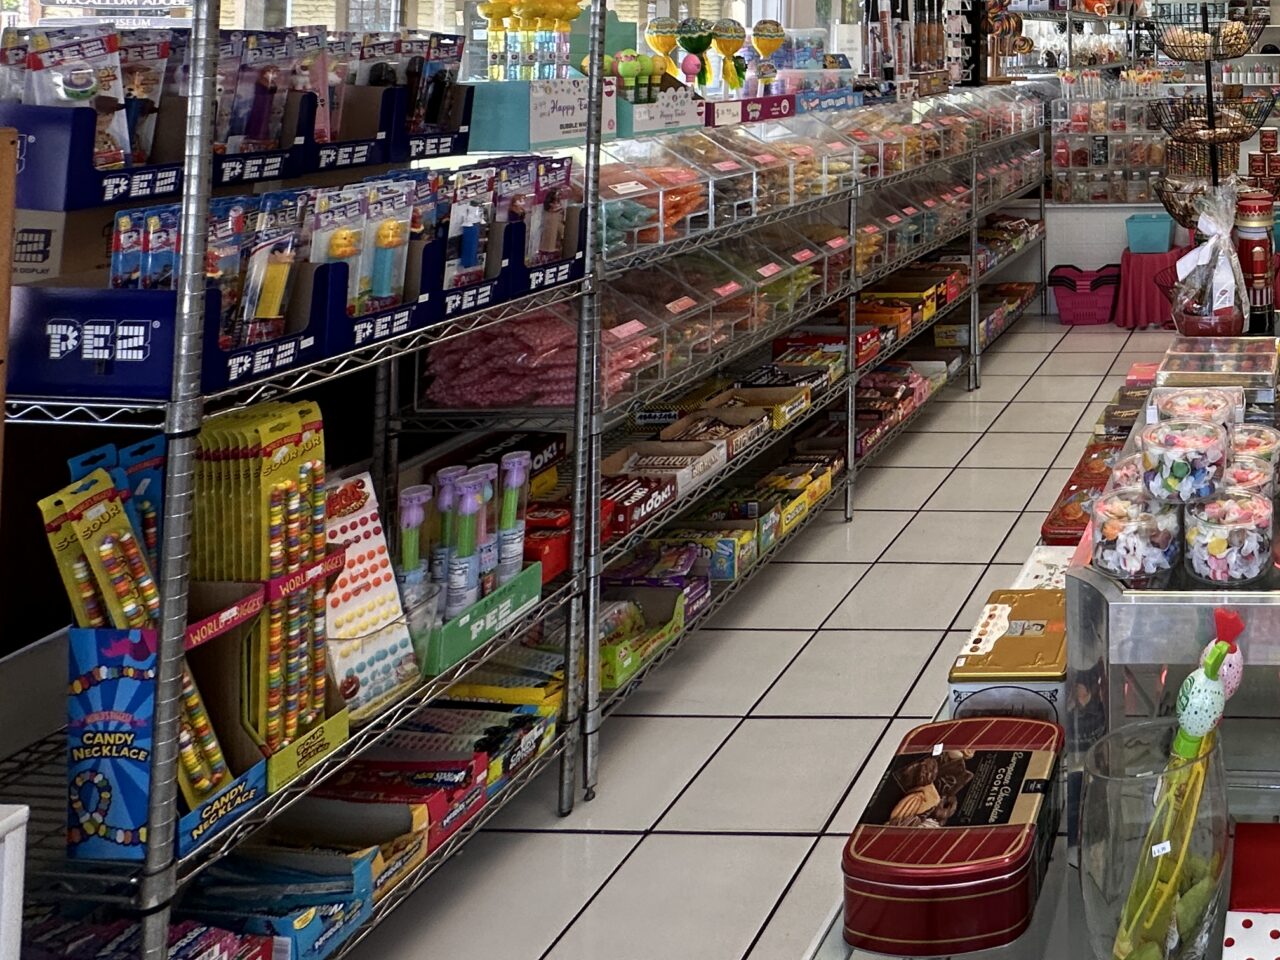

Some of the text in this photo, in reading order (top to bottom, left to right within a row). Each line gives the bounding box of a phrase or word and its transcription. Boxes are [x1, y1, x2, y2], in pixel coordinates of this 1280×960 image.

[319, 145, 369, 171] PEZ
[410, 137, 453, 157] PEZ
[102, 170, 178, 202] PEZ
[221, 157, 283, 183] PEZ
[529, 265, 570, 290] PEZ
[446, 286, 492, 314] PEZ
[46, 324, 146, 360] PEZ
[354, 309, 409, 345] PEZ
[227, 340, 296, 381] PEZ
[640, 483, 672, 517] LOOK!
[82, 504, 121, 540] SOUR
[470, 599, 512, 641] PEZ
[73, 744, 149, 763] NECKLACE
[82, 731, 135, 746] CANDY
[201, 781, 247, 820] CANDY
[985, 768, 1004, 807] COOKIES
[191, 788, 257, 840] NECKLACE
